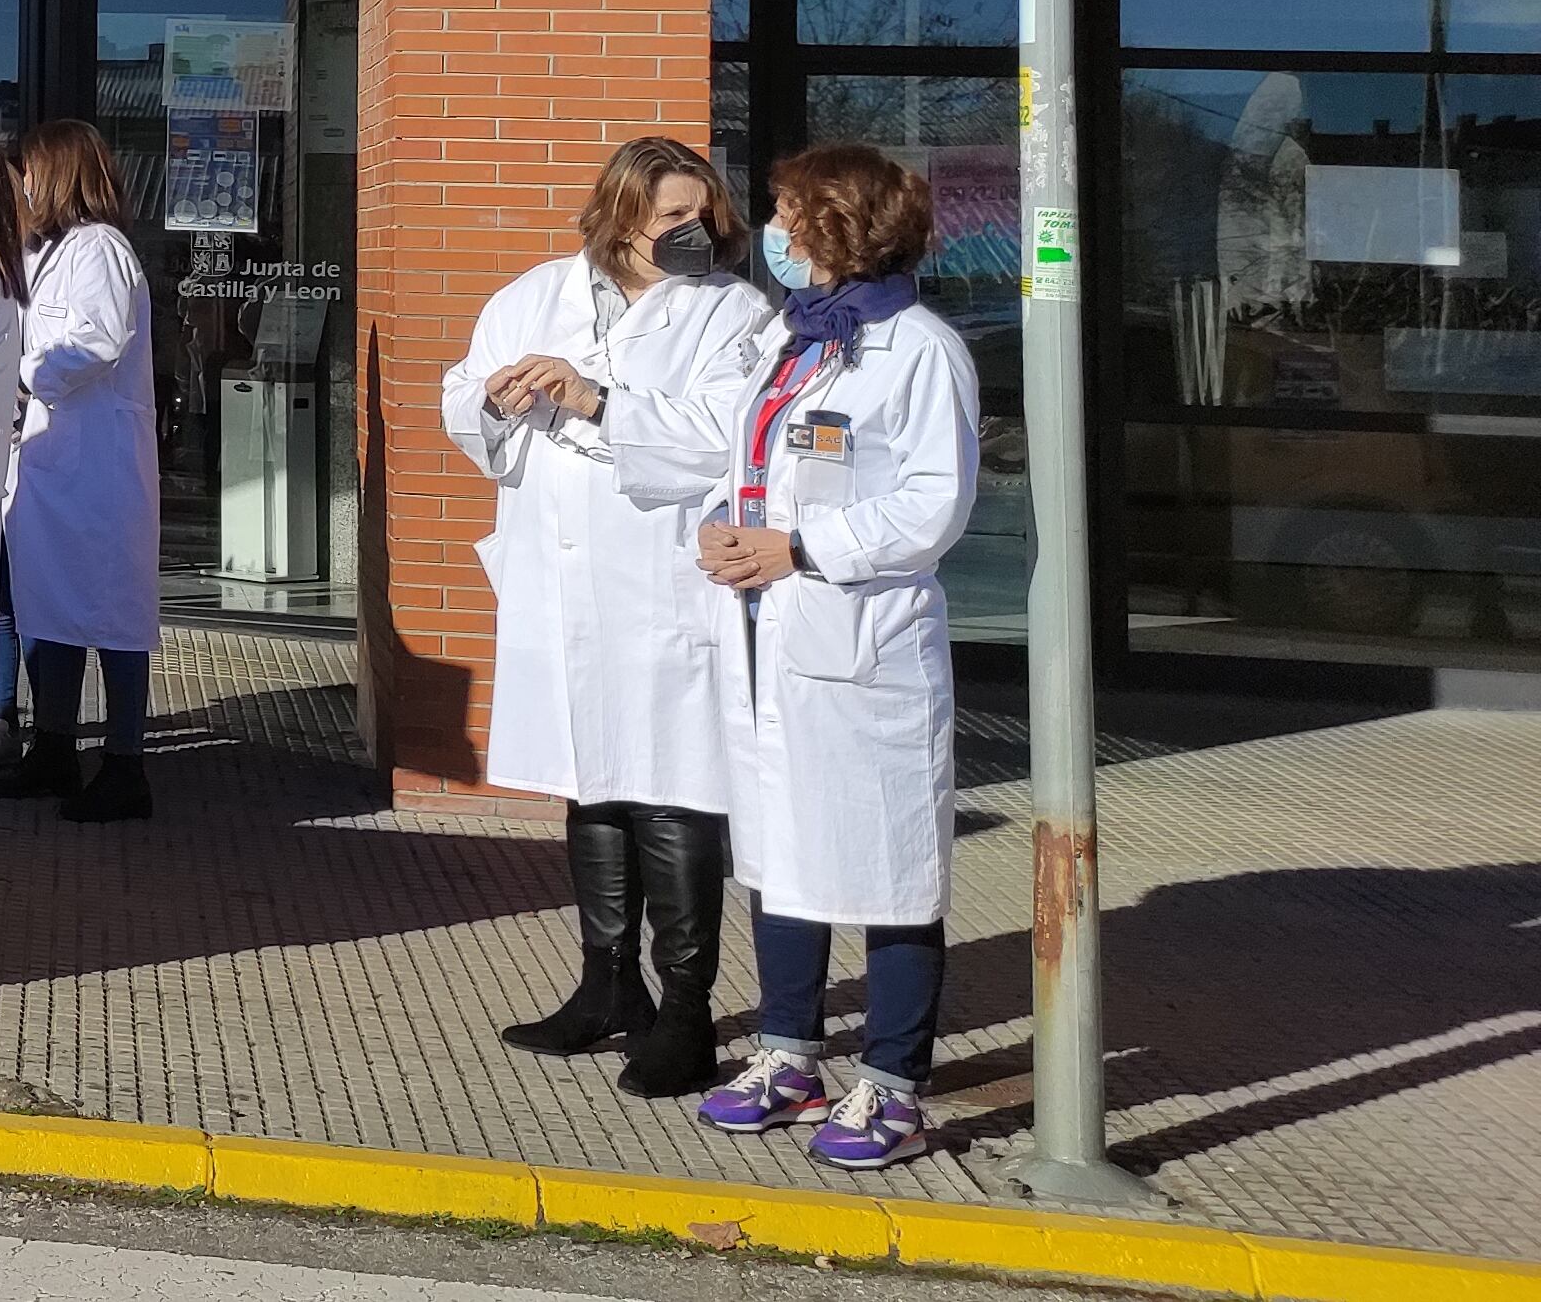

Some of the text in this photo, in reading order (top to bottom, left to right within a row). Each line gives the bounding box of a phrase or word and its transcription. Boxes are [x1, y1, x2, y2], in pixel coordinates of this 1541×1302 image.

[240, 259, 340, 277] Junta de
[177, 280, 258, 299] Castilla
[263, 284, 277, 303] y
